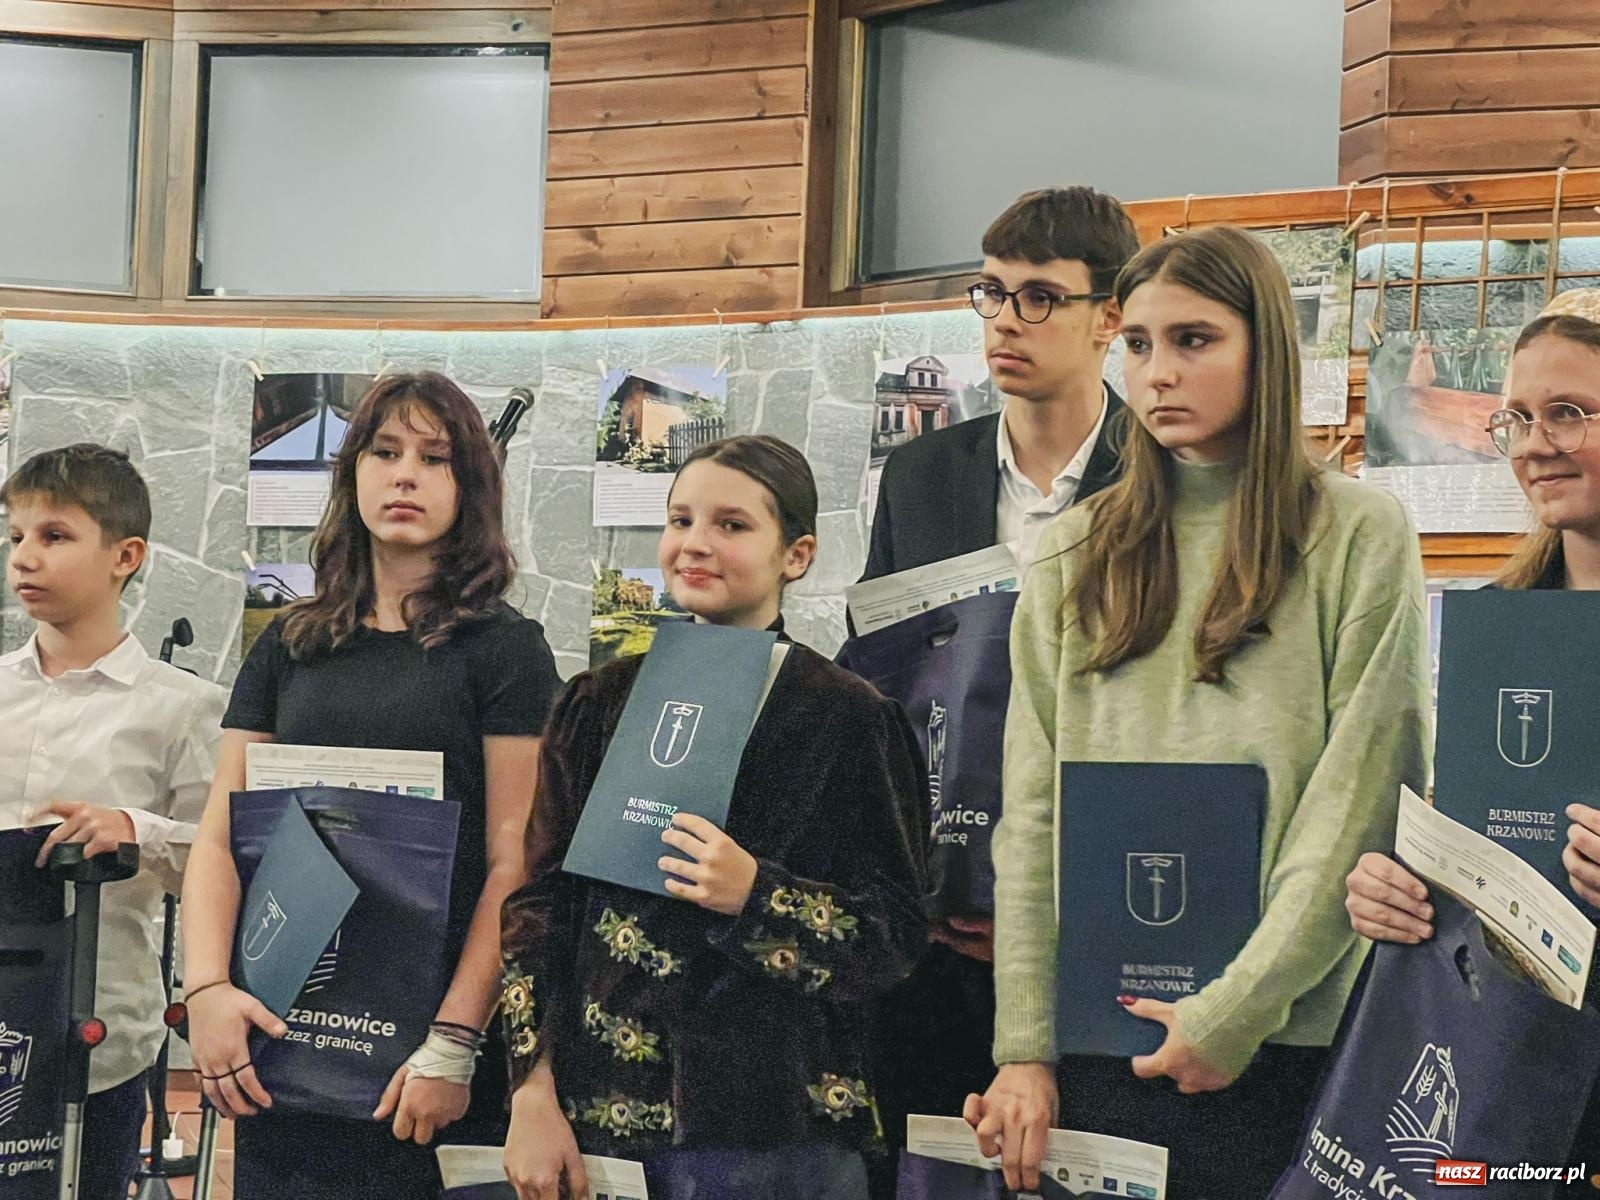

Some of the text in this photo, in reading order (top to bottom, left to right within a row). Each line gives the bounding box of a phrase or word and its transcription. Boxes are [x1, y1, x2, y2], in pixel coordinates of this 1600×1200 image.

[627, 797, 678, 816] BURMISTRZ
[940, 803, 989, 826] wice
[1488, 808, 1556, 825] BURMISTRZ
[1486, 824, 1556, 842] KRZANOWIC
[285, 1008, 396, 1037] zanowice
[284, 1030, 373, 1056] zez granicę
[1310, 1116, 1366, 1179] mina
